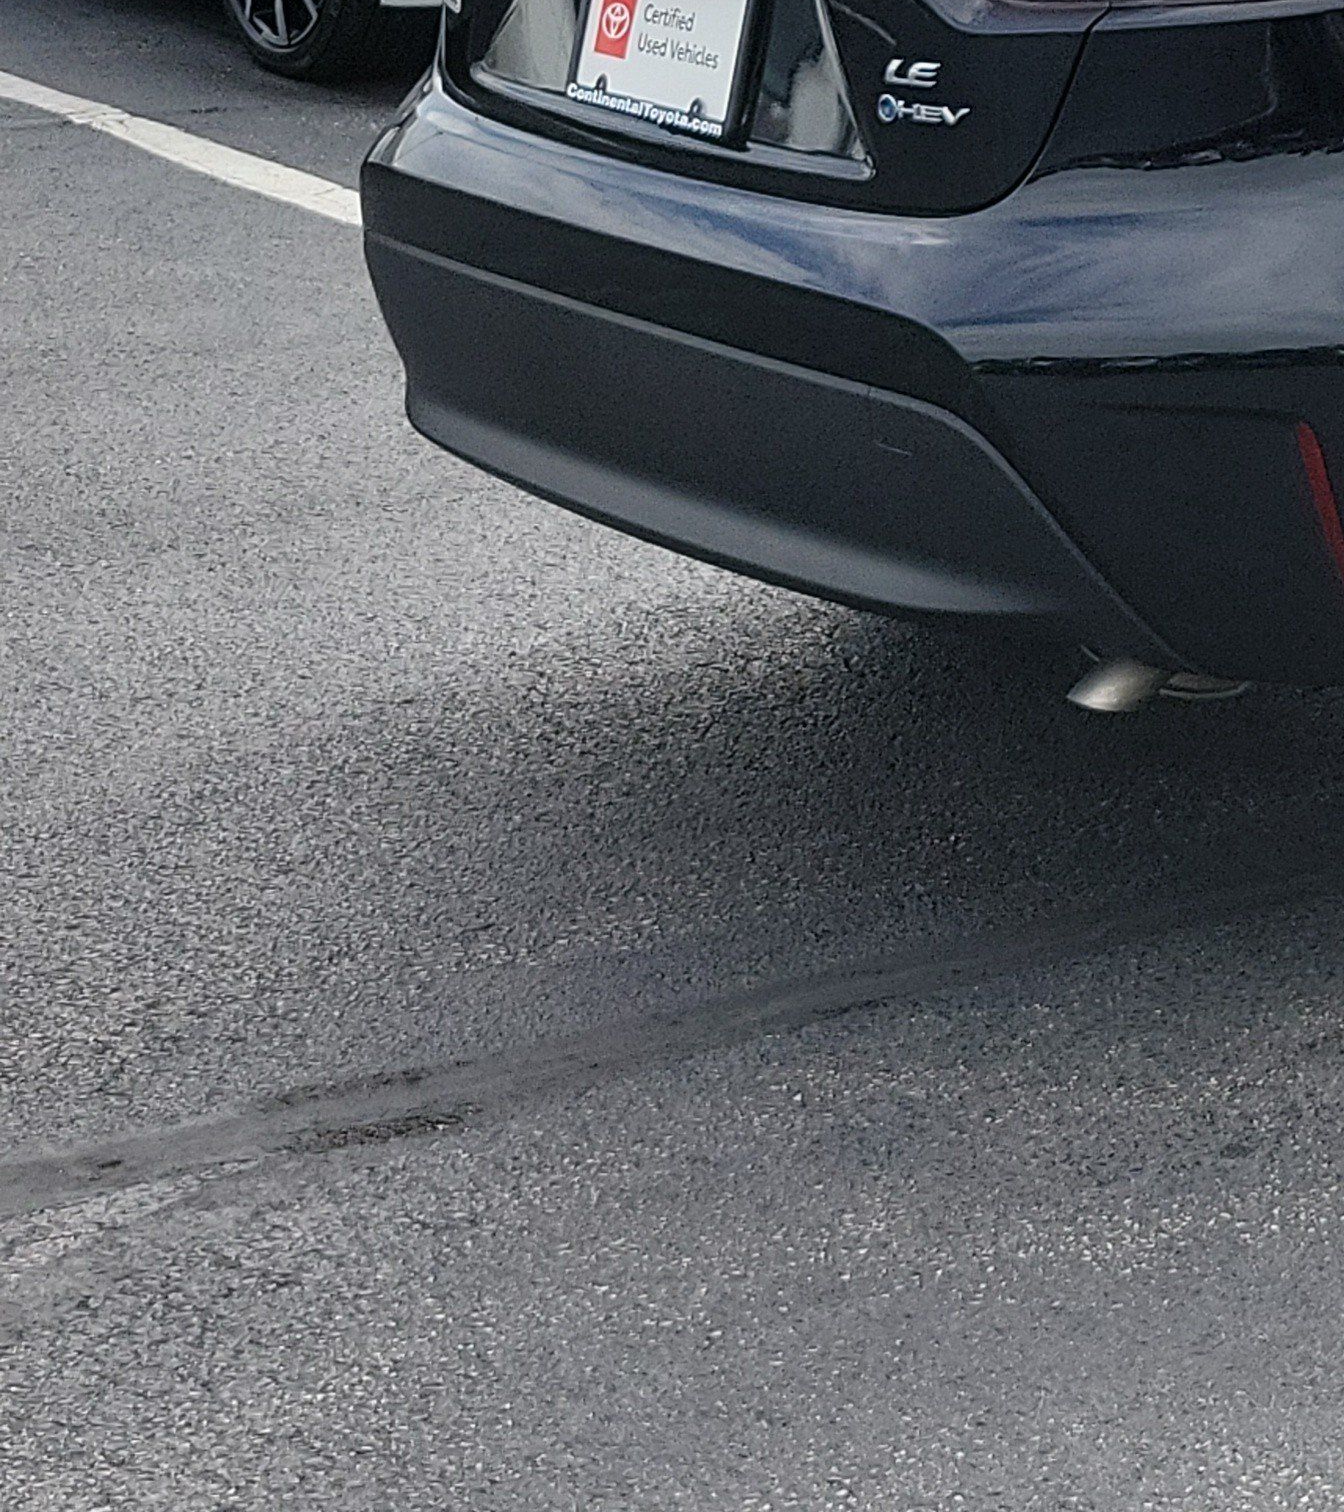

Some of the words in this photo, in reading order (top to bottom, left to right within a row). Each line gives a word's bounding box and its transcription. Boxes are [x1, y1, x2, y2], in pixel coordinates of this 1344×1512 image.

[643, 3, 696, 32] Certified
[637, 33, 669, 57] Used
[670, 43, 720, 69] Vehicles
[884, 58, 942, 88] LE
[566, 82, 723, 137] ContinentalToyota.com
